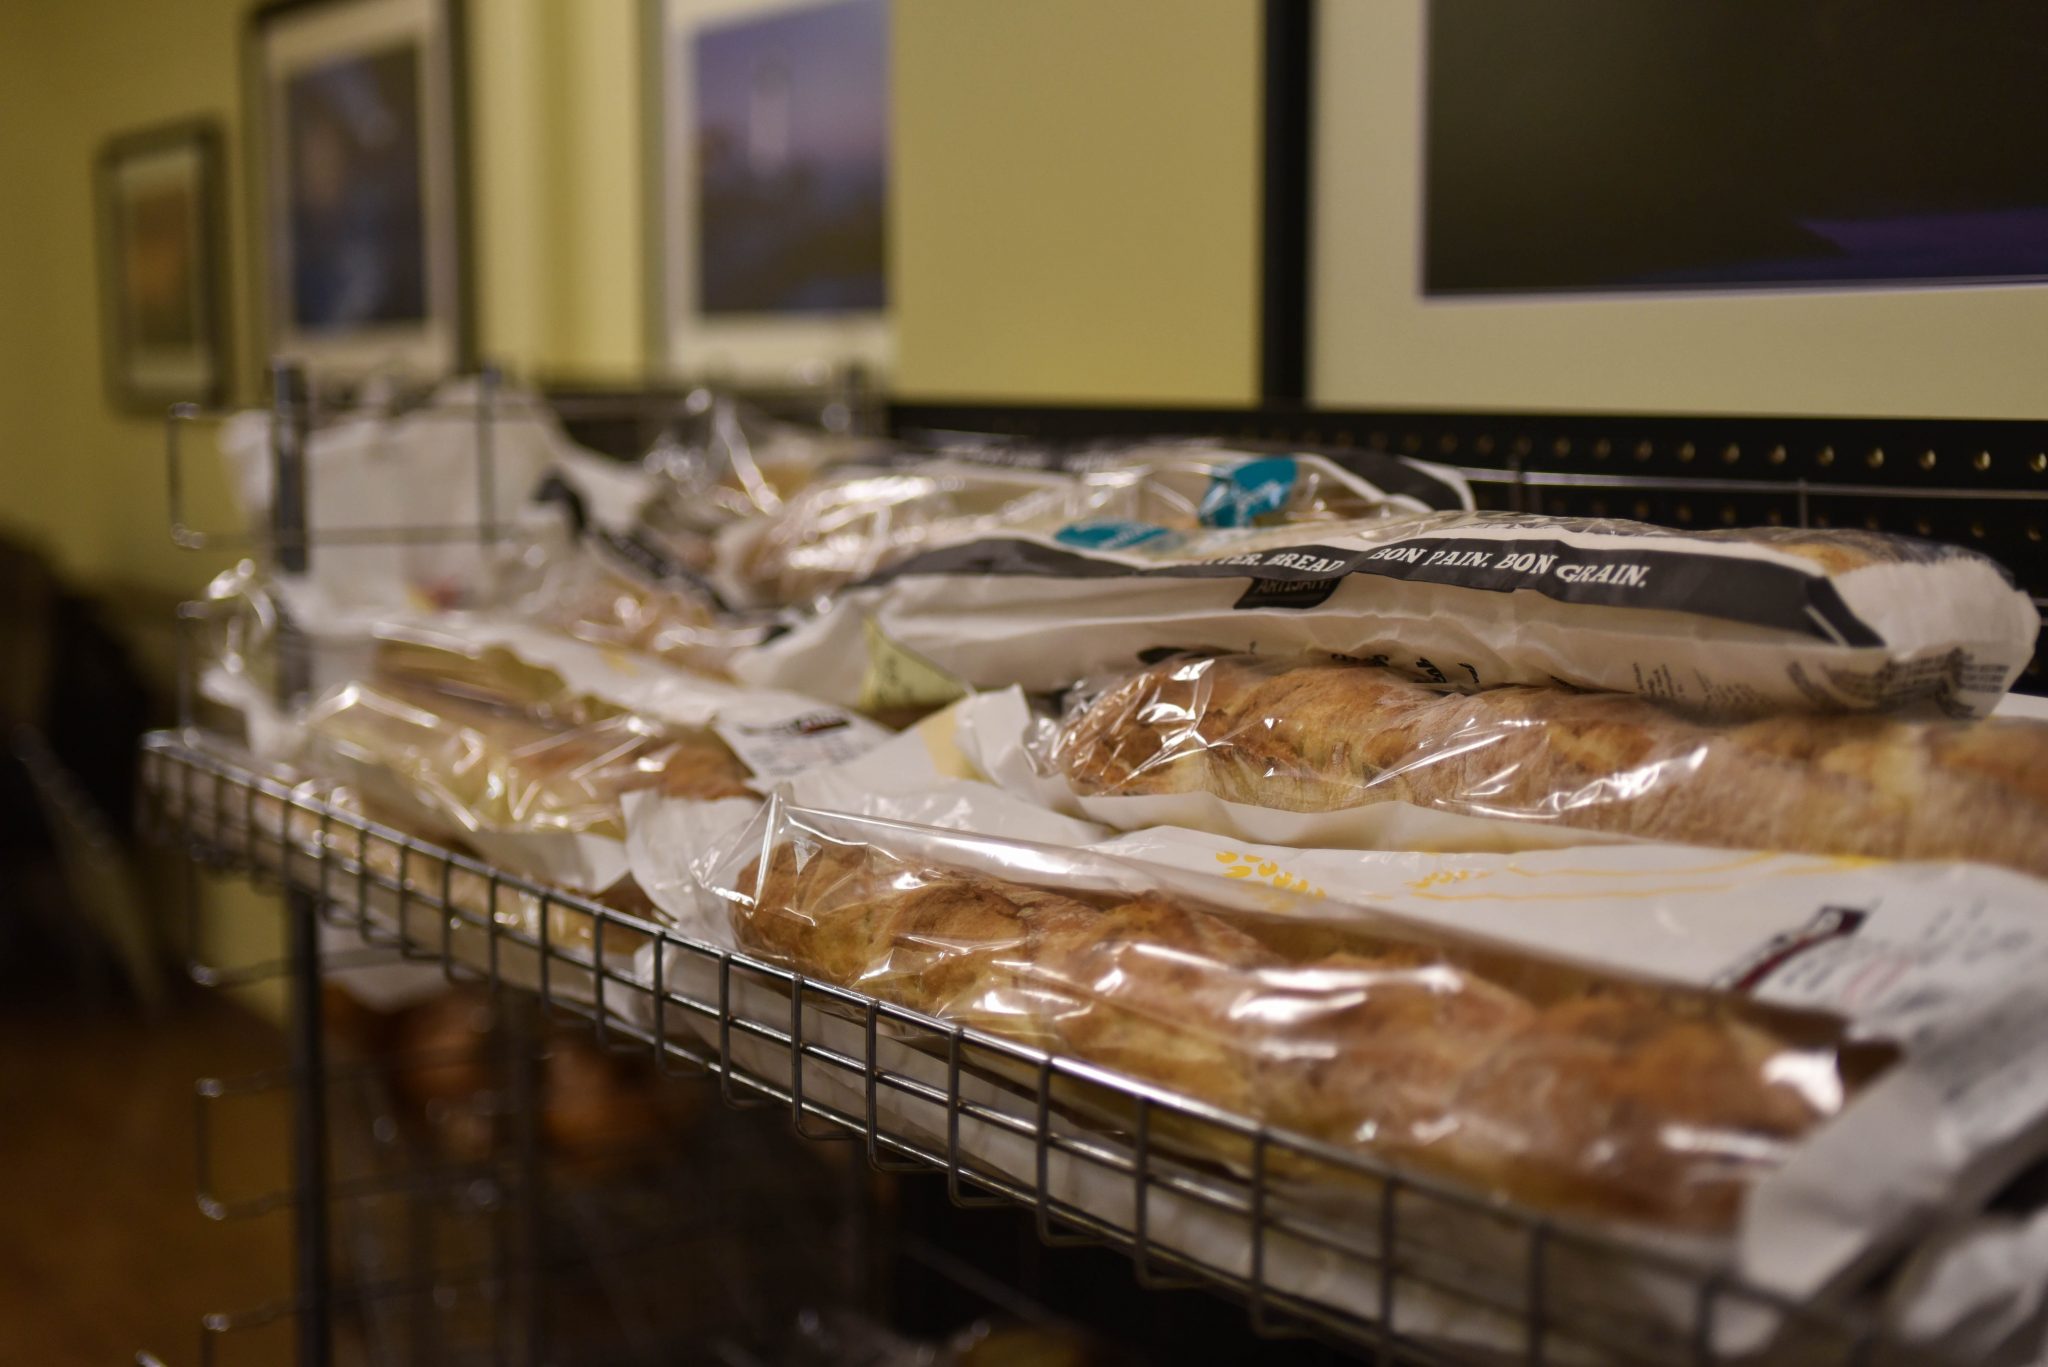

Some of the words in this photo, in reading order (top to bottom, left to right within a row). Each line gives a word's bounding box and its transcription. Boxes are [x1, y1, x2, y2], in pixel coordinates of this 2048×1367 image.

[1264, 553, 1345, 572] BREAD
[1367, 547, 1427, 565] BON
[1422, 550, 1494, 568] PAIN.
[1495, 553, 1558, 574] BON
[1556, 564, 1650, 587] GRAIN.
